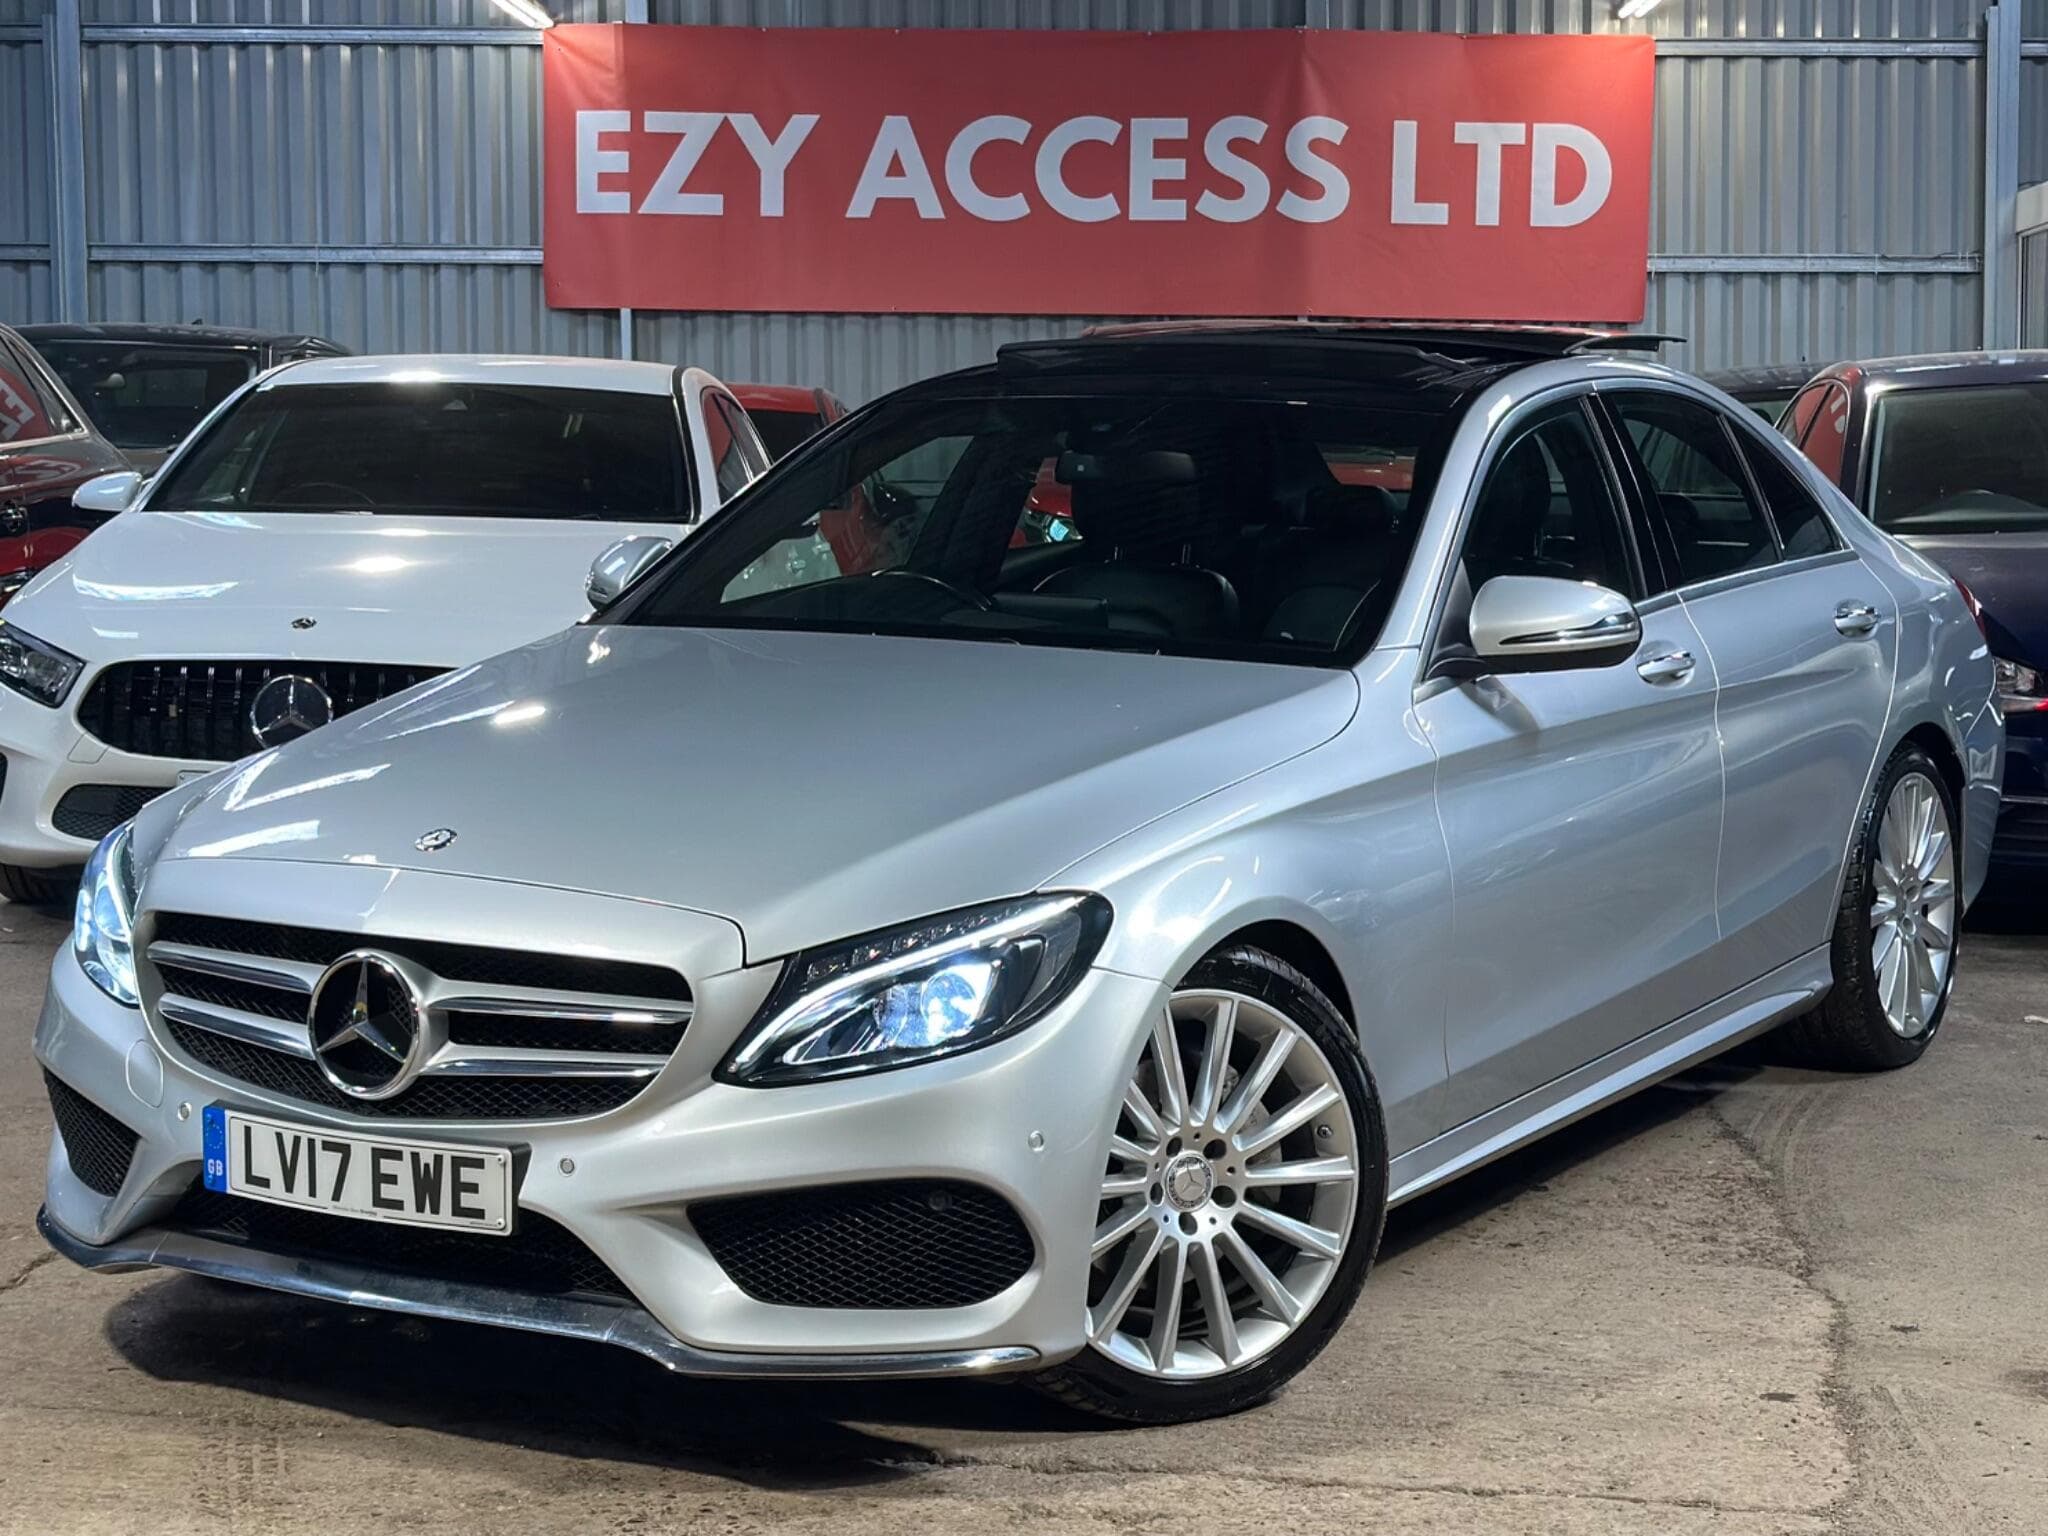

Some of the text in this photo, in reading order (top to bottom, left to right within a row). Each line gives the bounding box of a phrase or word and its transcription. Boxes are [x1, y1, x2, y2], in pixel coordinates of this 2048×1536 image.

[575, 110, 1613, 227] EZY ACCESS LTD
[207, 1158, 224, 1177] GB
[243, 1125, 486, 1220] LV17 EWE
